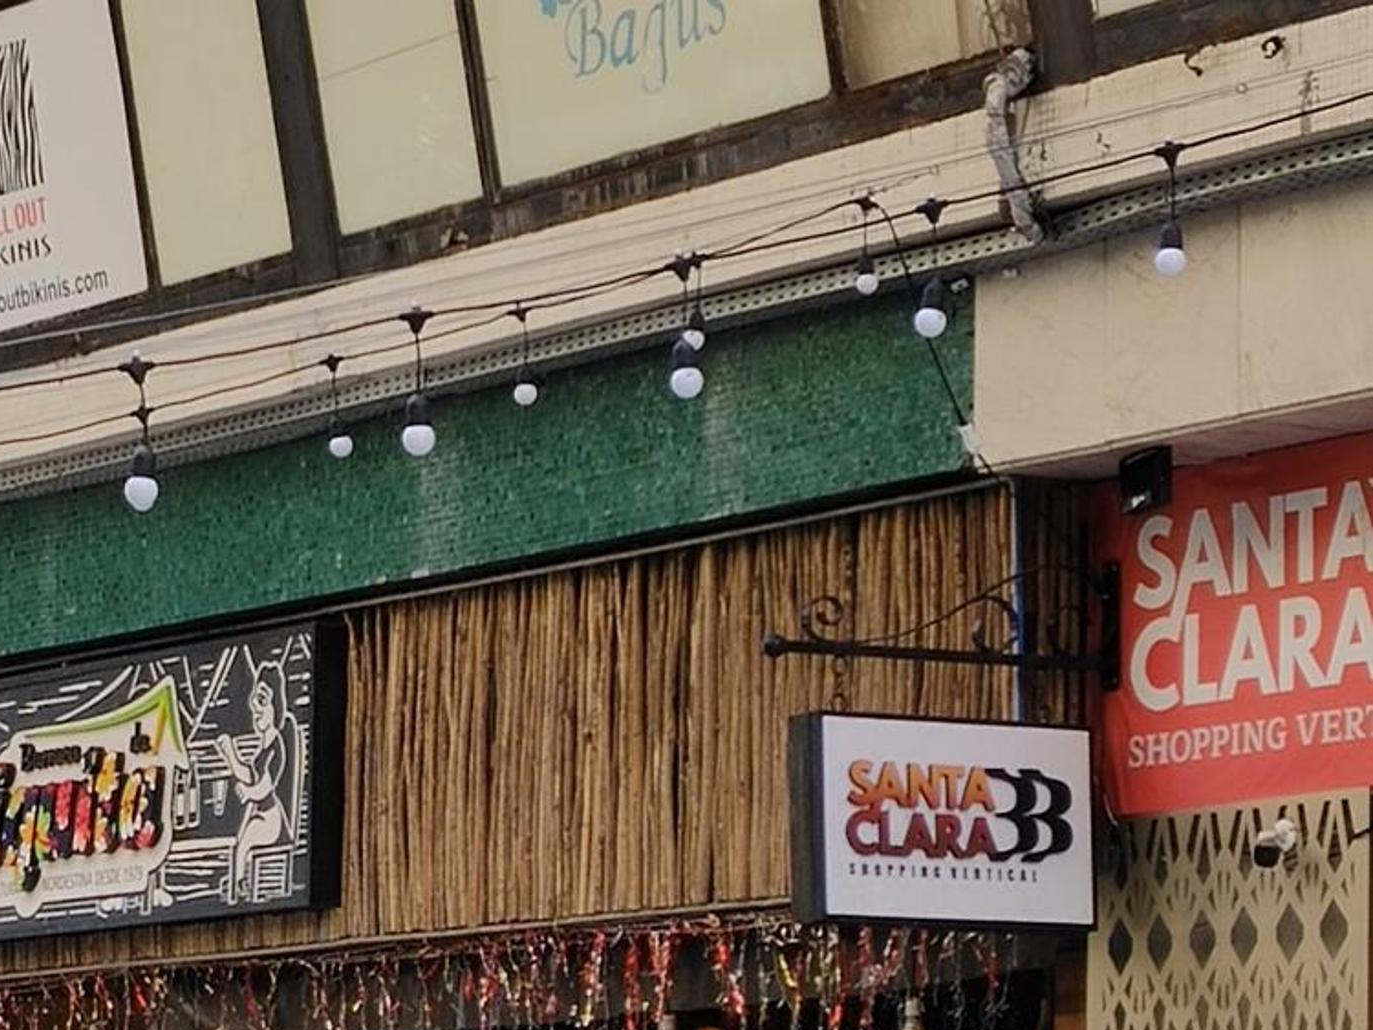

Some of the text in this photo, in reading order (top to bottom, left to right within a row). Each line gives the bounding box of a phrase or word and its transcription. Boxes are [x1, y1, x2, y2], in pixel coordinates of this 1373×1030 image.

[1133, 481, 1373, 609] SANTA
[1130, 587, 1373, 711] CLARA
[1130, 716, 1287, 768] SHOPPING
[847, 759, 996, 811] SANTA
[845, 808, 999, 860] CLARA
[848, 862, 1038, 882] SHOPPING VERTICAL
